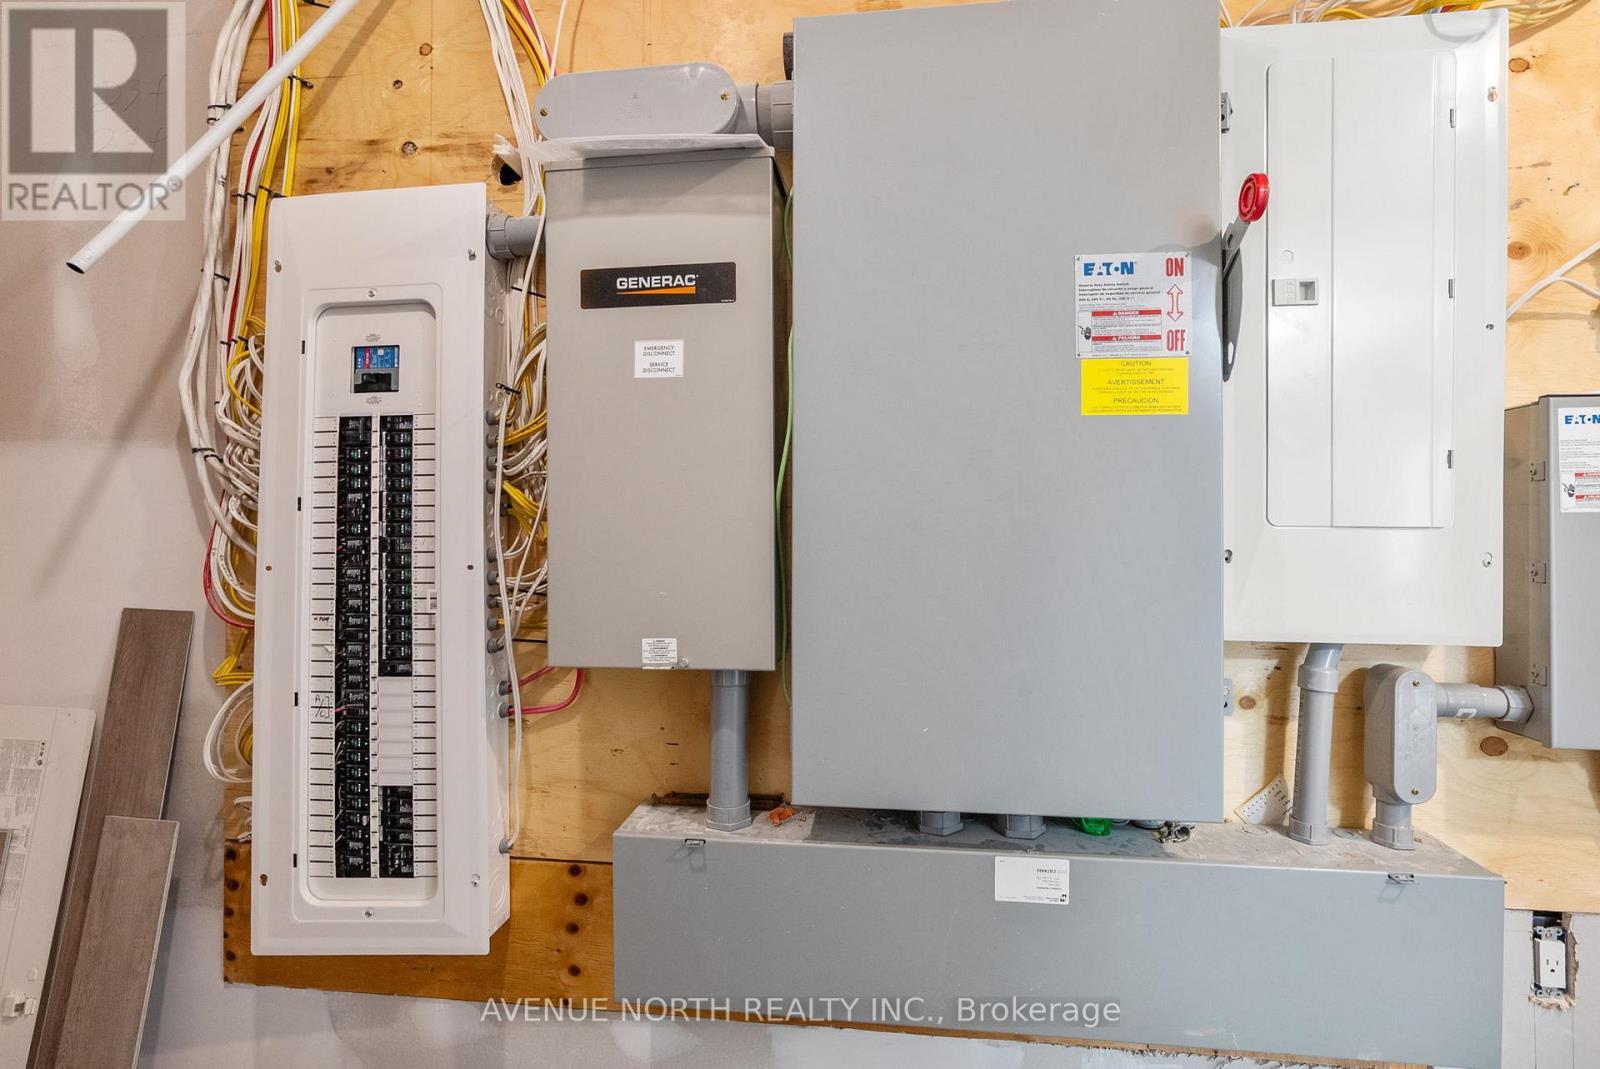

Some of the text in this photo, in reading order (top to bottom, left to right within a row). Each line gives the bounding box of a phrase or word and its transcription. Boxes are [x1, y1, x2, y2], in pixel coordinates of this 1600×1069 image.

[1165, 257, 1185, 277] ON
[616, 274, 696, 290] GENERAC
[1166, 329, 1187, 352] OFF
[1107, 378, 1165, 386] AVERTISSEMENT
